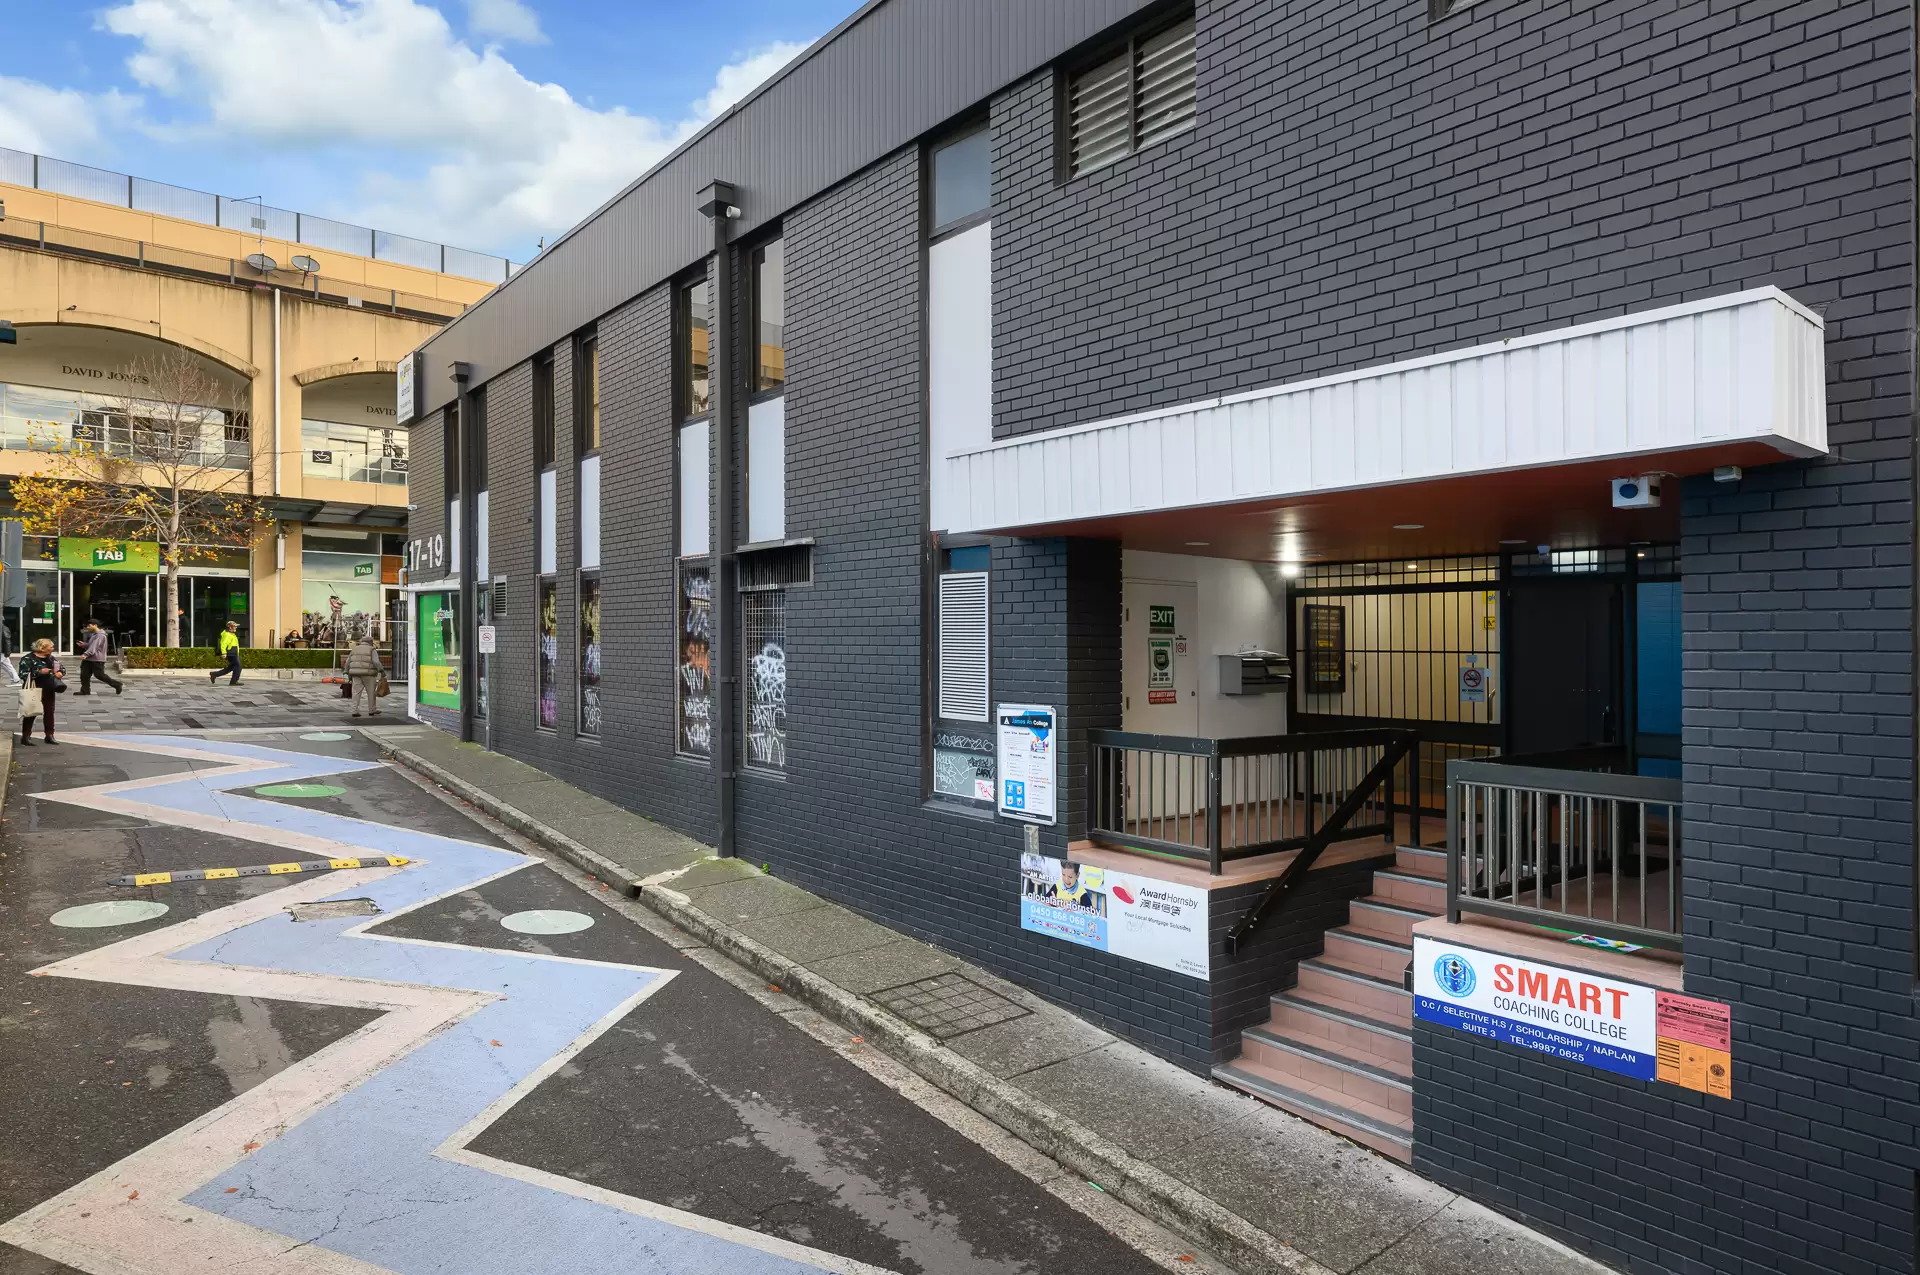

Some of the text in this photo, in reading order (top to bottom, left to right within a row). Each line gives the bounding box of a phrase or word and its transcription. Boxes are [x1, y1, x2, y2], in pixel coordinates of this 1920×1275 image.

[62, 365, 149, 385] DAVID JONES
[366, 405, 396, 416] DAVID
[95, 550, 124, 561] TAB
[409, 533, 443, 572] 17-19
[355, 566, 372, 574] TAB
[1150, 610, 1174, 623] EXIT
[1033, 719, 1049, 728] College
[1028, 892, 1101, 917] globalart Hornsby
[1140, 887, 1199, 910] Award Hornsby
[1030, 905, 1051, 917] 0450
[1069, 914, 1085, 926] 068
[1135, 913, 1148, 922] Local
[1148, 916, 1169, 927] Mortgage
[1169, 922, 1192, 933] Solutions
[1493, 963, 1630, 1020] SMART
[1493, 995, 1628, 1041] COACHING COLLEGE
[1421, 1000, 1436, 1010] O.C
[1443, 1005, 1490, 1024] SELECTIVE
[1491, 1018, 1508, 1029] H.S
[1515, 1025, 1583, 1048] SCHOLARSHIP
[1593, 1045, 1636, 1063] NAPLAN
[1462, 1022, 1488, 1036] SUITE
[1559, 1048, 1585, 1062] 0625
